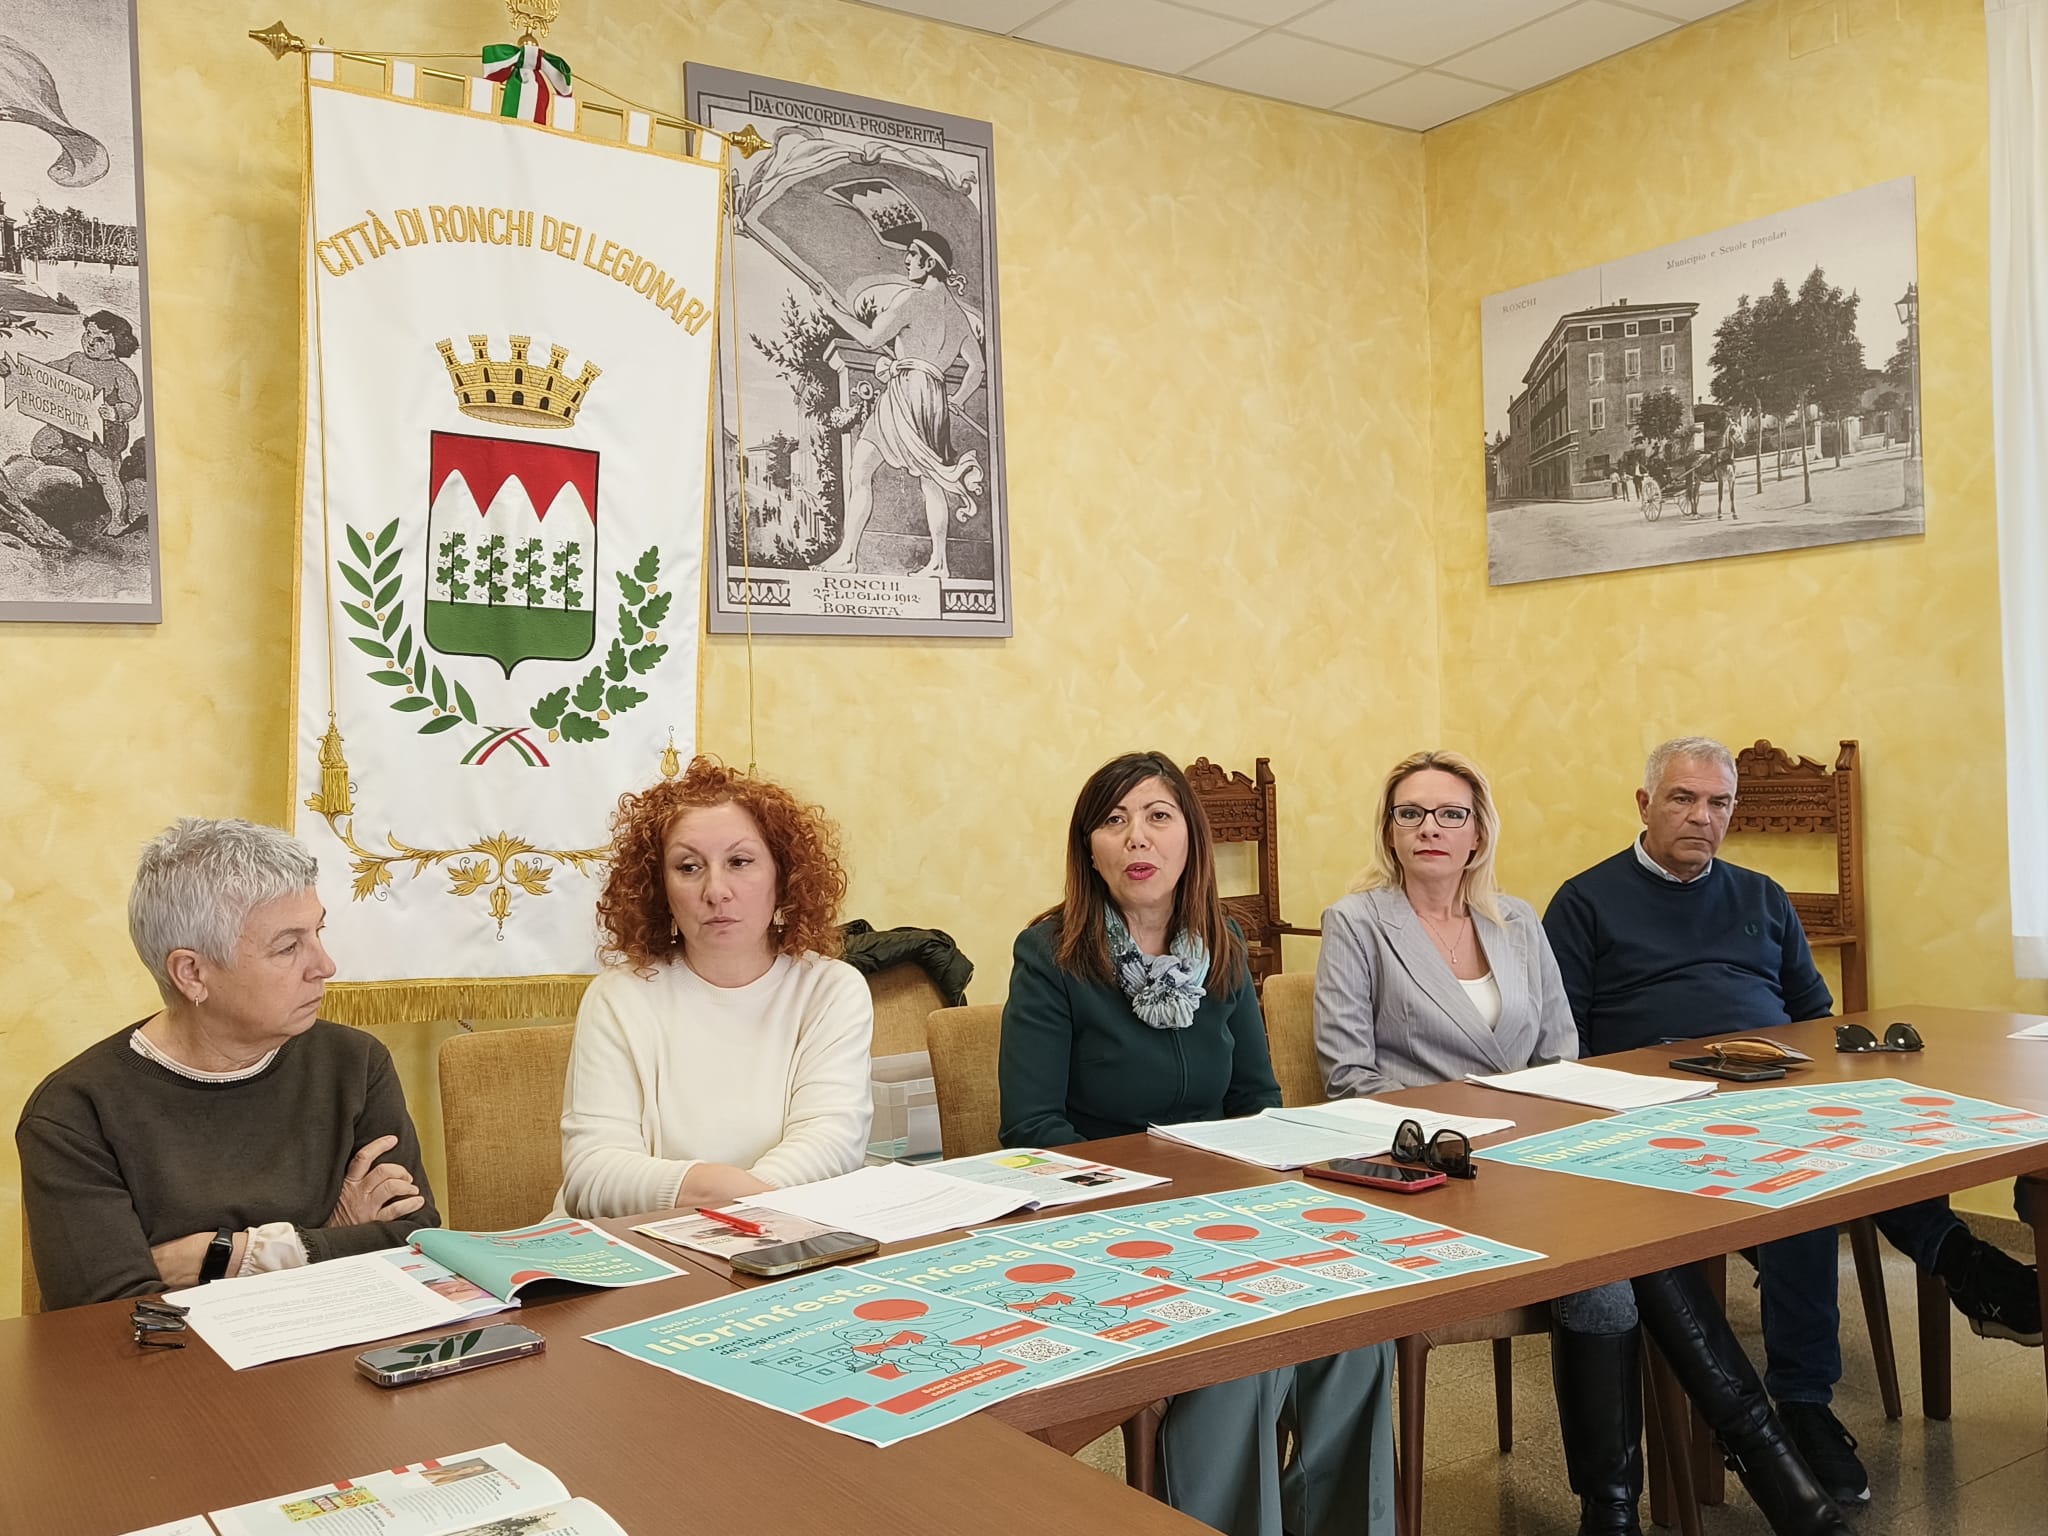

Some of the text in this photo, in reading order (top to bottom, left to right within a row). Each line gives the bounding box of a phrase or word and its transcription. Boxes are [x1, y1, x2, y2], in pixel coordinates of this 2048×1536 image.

[754, 96, 772, 114] DA
[775, 101, 856, 128] CONCORDIA
[316, 204, 712, 336] CITTÀ DI RONCHI DEI LEGIONARI
[1502, 297, 1537, 312] RONCHI
[20, 363, 91, 403] DA CONCORDIA
[823, 577, 900, 592] RONCHI
[835, 590, 892, 602] LUGLIO
[895, 593, 920, 605] 1912
[823, 602, 901, 617] BORGATA
[645, 1283, 888, 1356] librinfesta
[709, 1336, 753, 1352] ronchi
[720, 1326, 802, 1356] dei legionari
